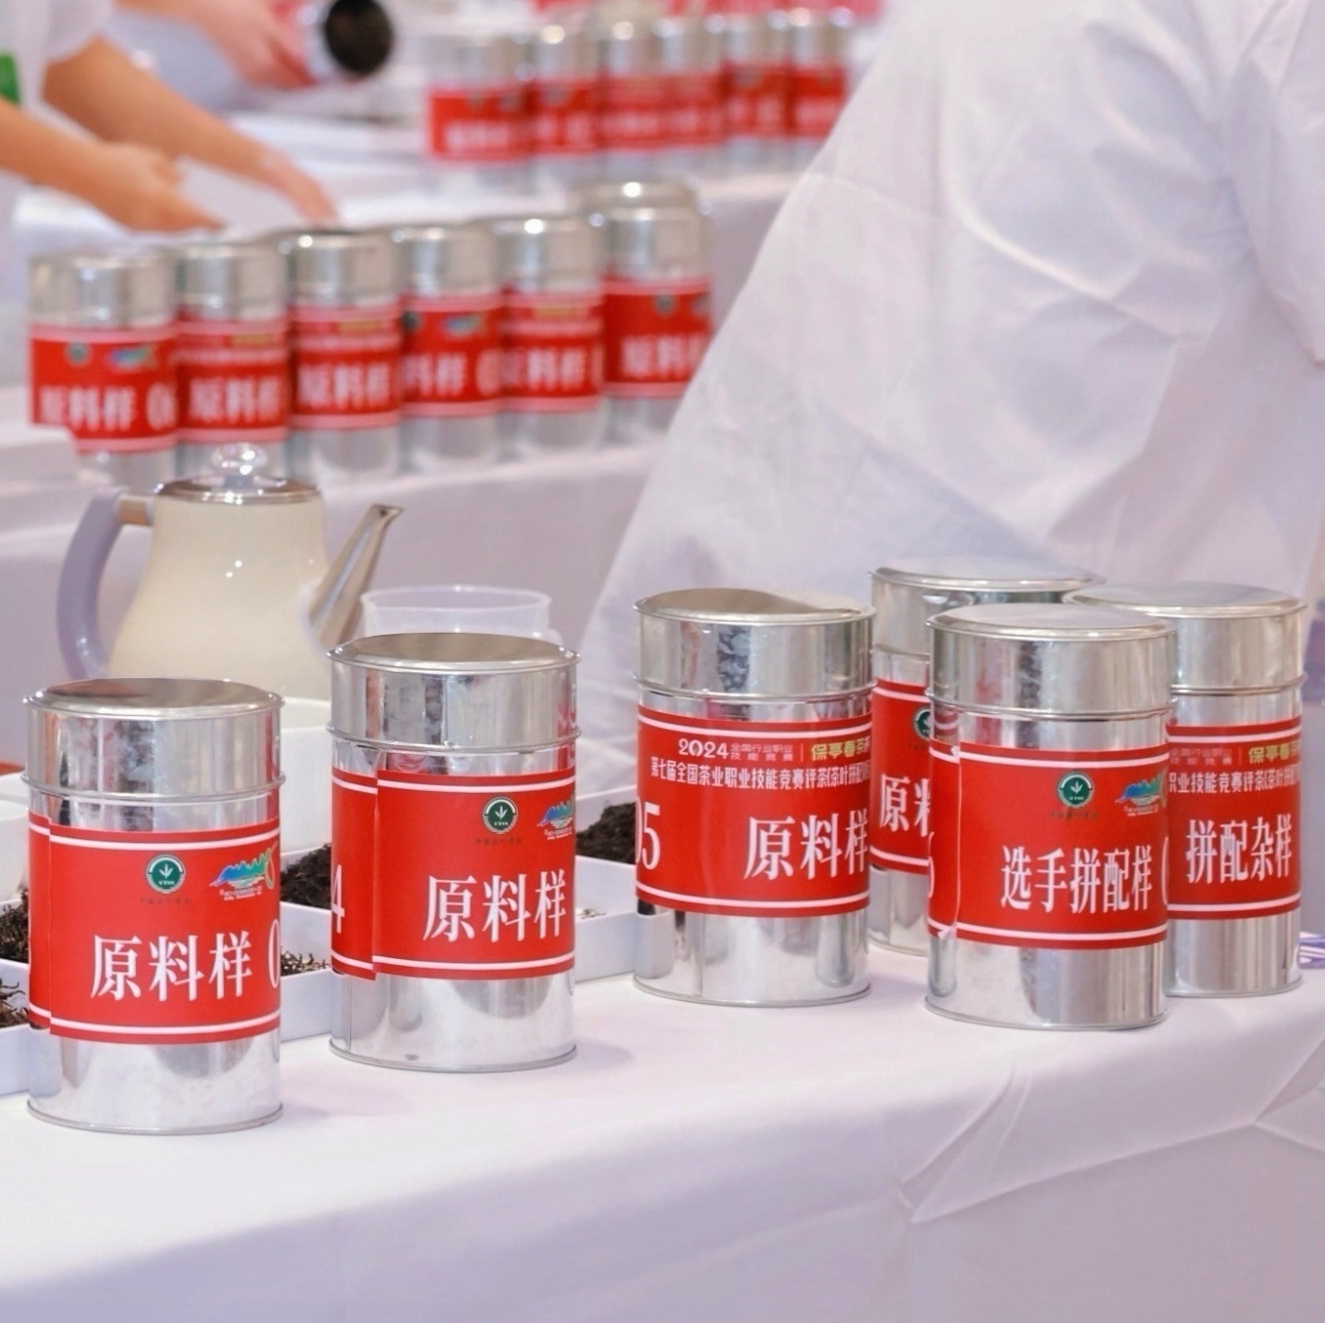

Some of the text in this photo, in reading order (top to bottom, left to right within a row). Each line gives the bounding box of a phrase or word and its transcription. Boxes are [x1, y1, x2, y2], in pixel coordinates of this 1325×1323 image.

[678, 737, 729, 760] 2024
[743, 807, 869, 881] 原料样
[1000, 844, 1153, 914] 选手拼配样
[1185, 813, 1293, 885] 拼配杂样
[422, 869, 568, 944] 原料样
[89, 930, 254, 1003] 原料样
